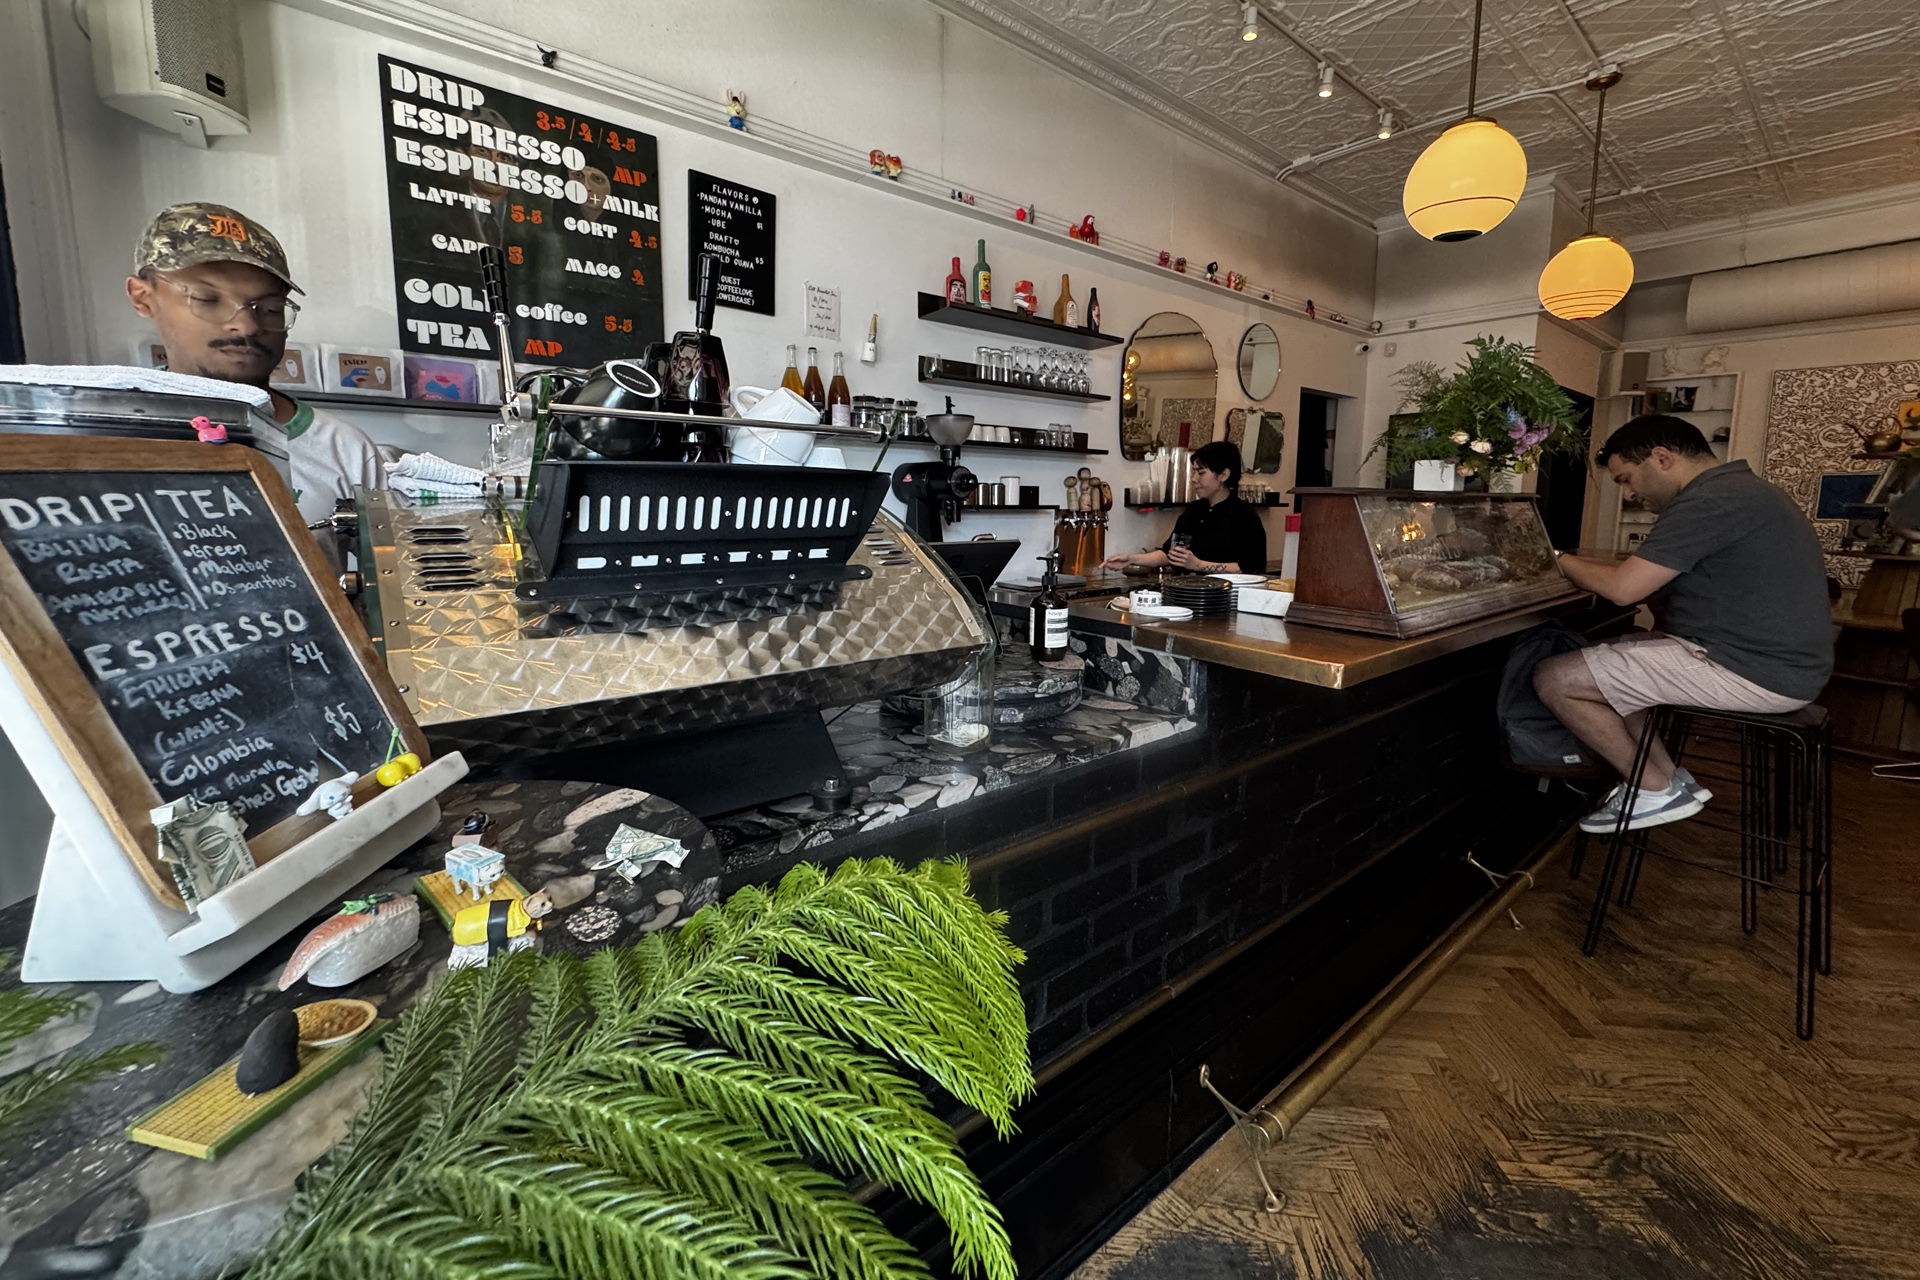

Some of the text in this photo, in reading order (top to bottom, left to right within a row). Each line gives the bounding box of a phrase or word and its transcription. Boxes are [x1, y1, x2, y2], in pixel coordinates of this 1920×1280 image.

[388, 63, 485, 111] DRIP
[536, 111, 566, 131] 3.5
[391, 99, 647, 187] ESPRESSO MP
[393, 136, 588, 204] ESPRESSO
[603, 194, 659, 222] MILK
[712, 184, 749, 202] FLAVORS
[409, 182, 491, 214] LATTE
[511, 204, 542, 225] 5.5
[564, 216, 618, 240] CORT
[700, 191, 762, 217] PANDAN VANILLA
[704, 205, 732, 220] MOCHA
[709, 231, 733, 245] DRAFT
[711, 218, 727, 229] UBE
[431, 233, 490, 255] CAP
[508, 246, 524, 265] 5
[565, 258, 622, 279] MACC
[703, 242, 740, 258] KOMBUCHA
[404, 278, 633, 333] COL coffee 5.5
[406, 319, 563, 357] TEA MP
[0, 493, 136, 531] DRIP
[155, 485, 253, 519] TEA
[17, 533, 132, 563] BOLIVIA
[178, 523, 237, 540] Black
[190, 544, 248, 559] Green
[198, 558, 272, 577] Malabar
[84, 608, 309, 681] ESPRESSO
[118, 641, 331, 708] ETHIOPIA $4
[324, 702, 362, 741] $5
[160, 737, 274, 787] Colombia
